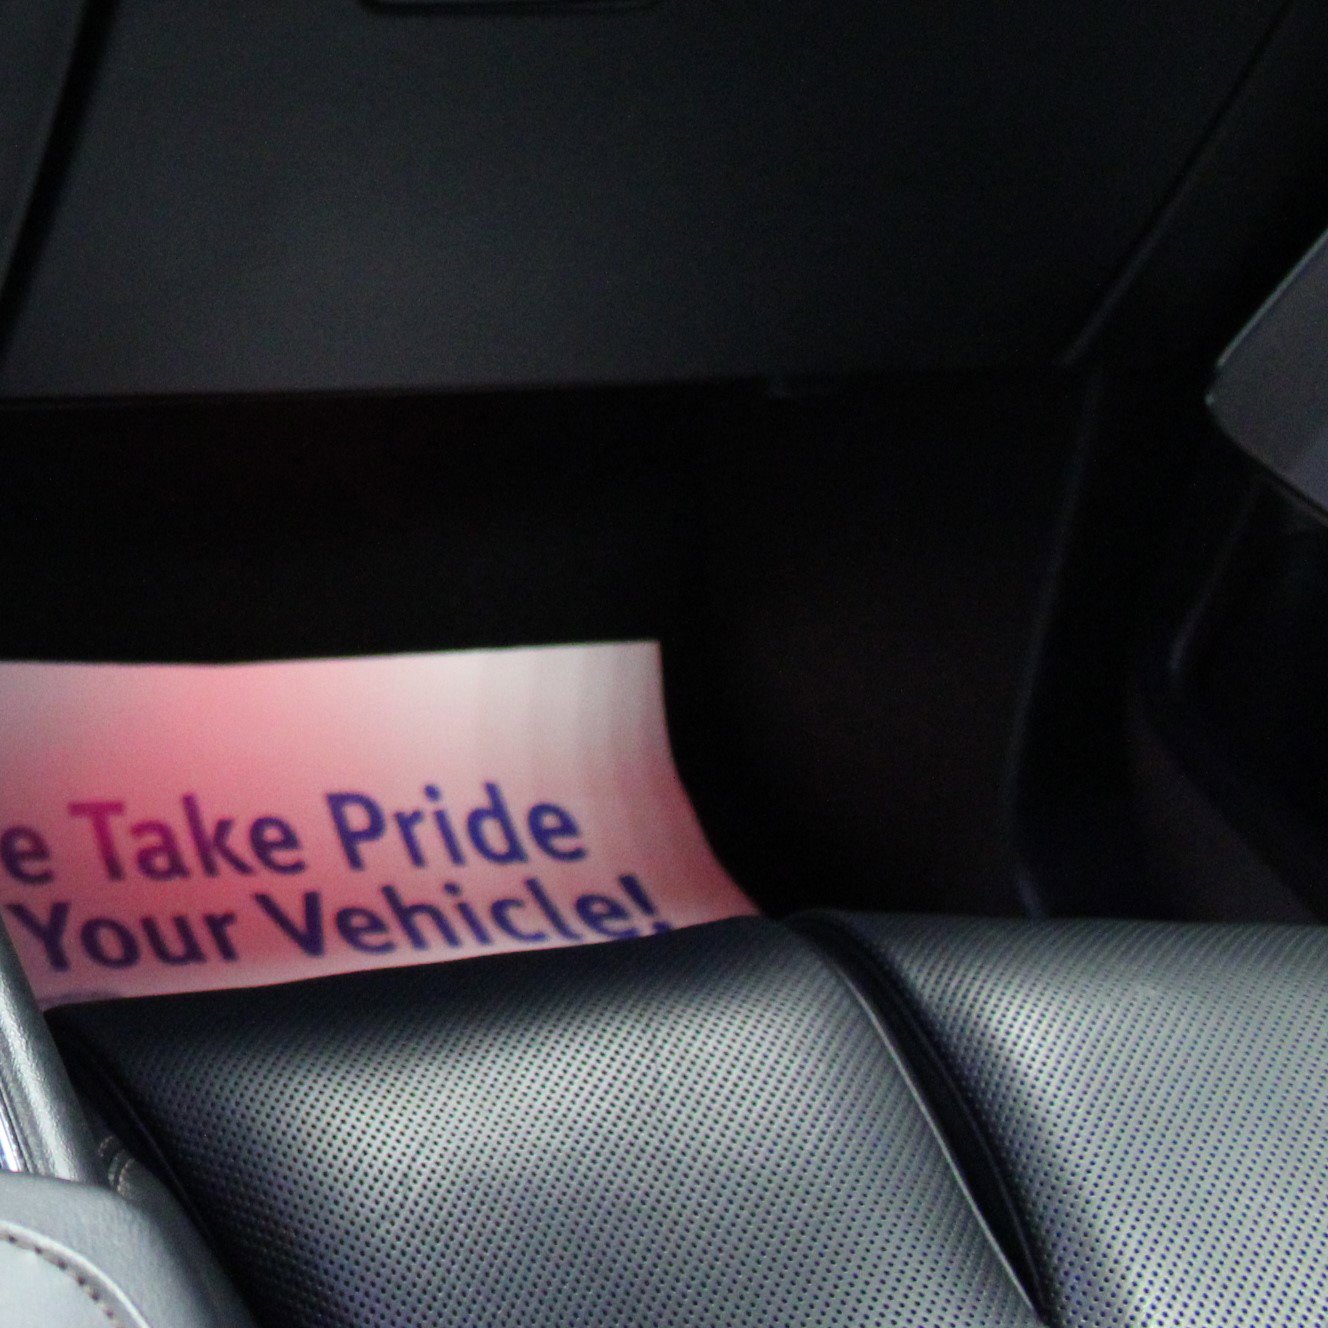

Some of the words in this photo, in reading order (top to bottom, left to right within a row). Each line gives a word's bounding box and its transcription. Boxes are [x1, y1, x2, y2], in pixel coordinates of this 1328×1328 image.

[67, 791, 308, 883] Take
[326, 780, 588, 872] Pride
[6, 900, 239, 972] Your
[253, 874, 673, 959] Vehicle!
